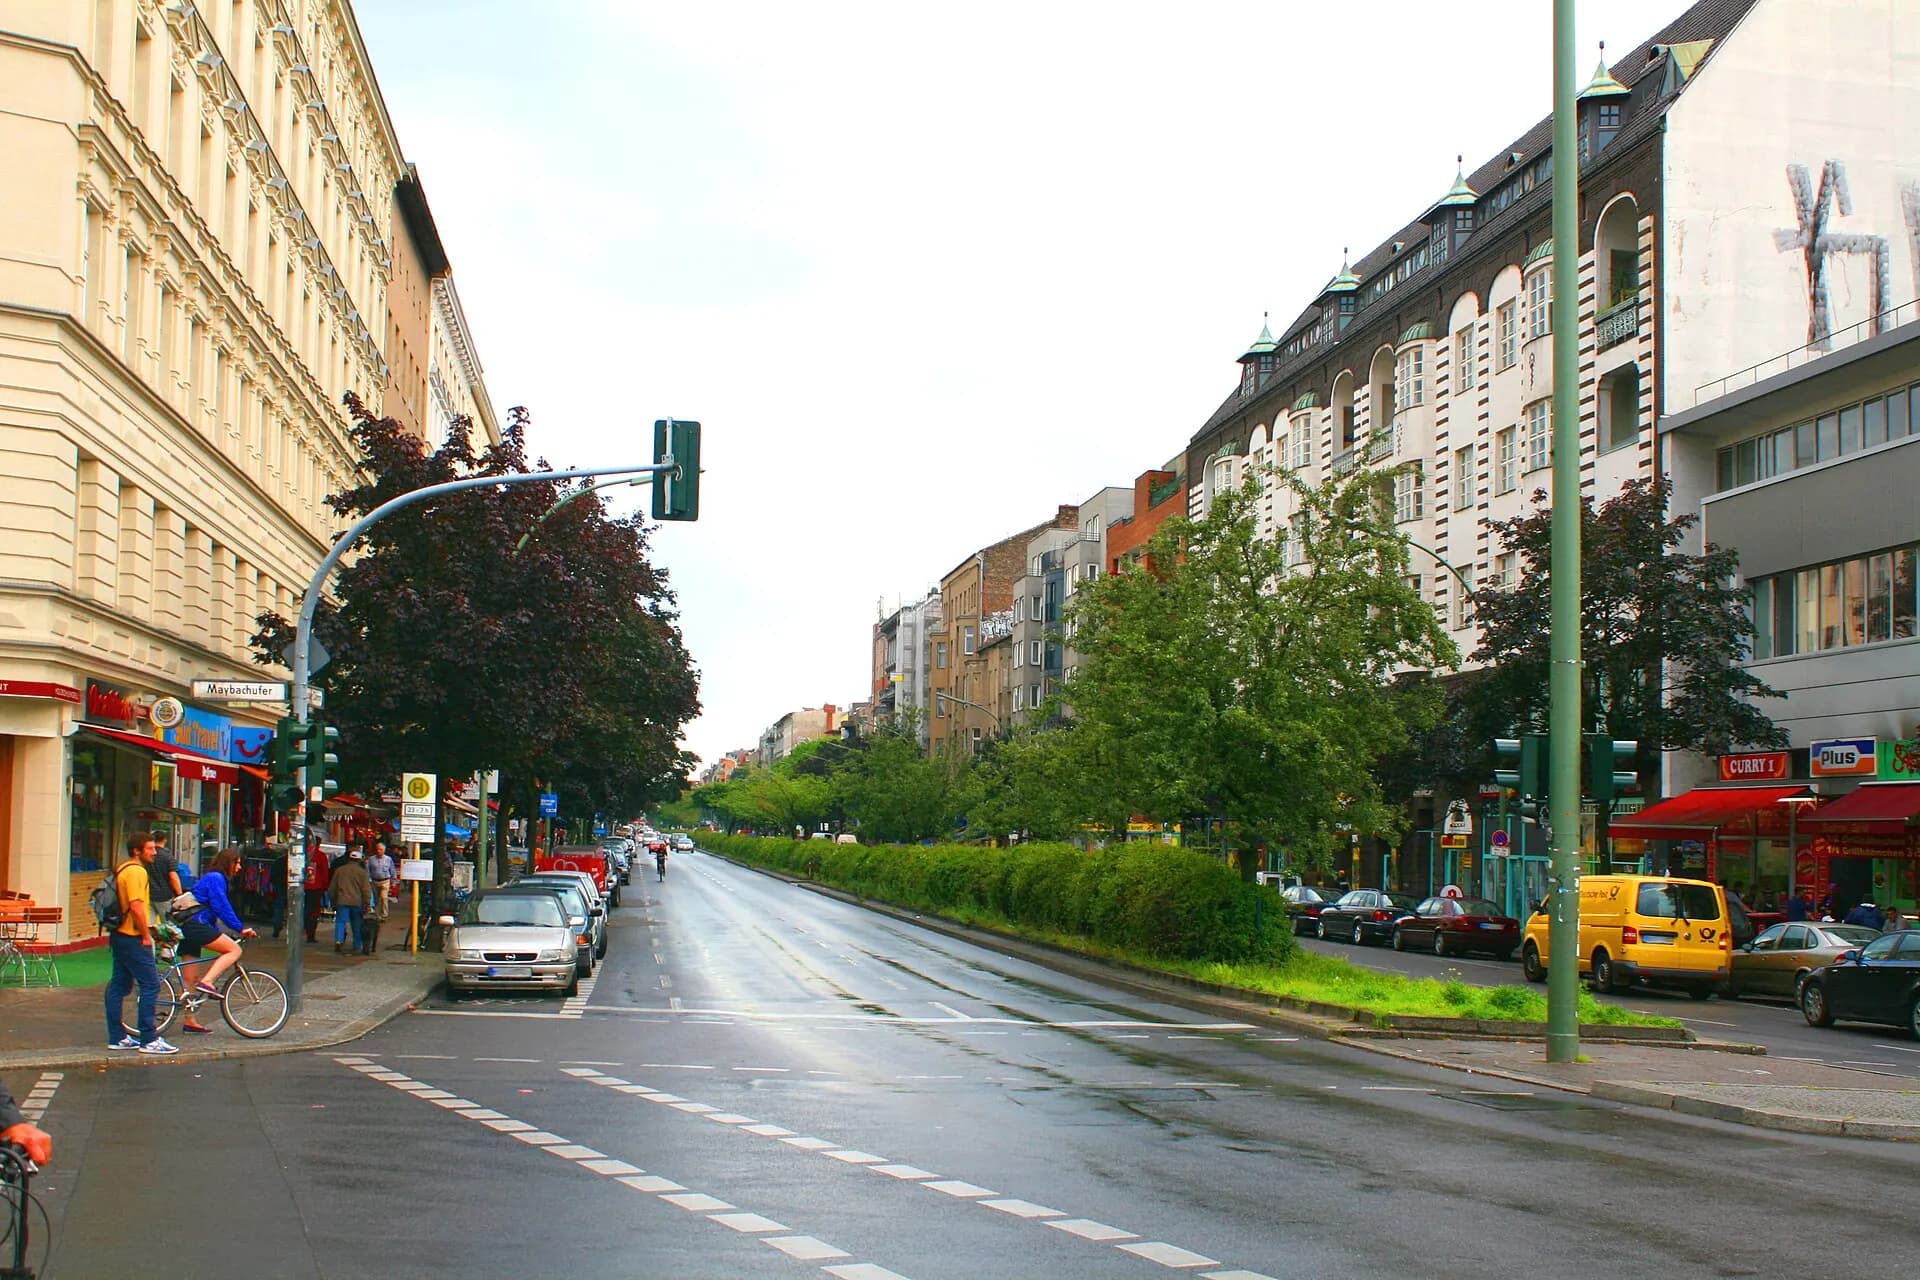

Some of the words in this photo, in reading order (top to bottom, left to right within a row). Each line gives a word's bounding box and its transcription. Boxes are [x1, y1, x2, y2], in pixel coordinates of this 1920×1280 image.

[207, 683, 273, 697] Maybachufer
[1821, 750, 1856, 765] Plus
[1730, 758, 1766, 774] CURRY
[1768, 760, 1775, 772] 1
[413, 782, 423, 796] H
